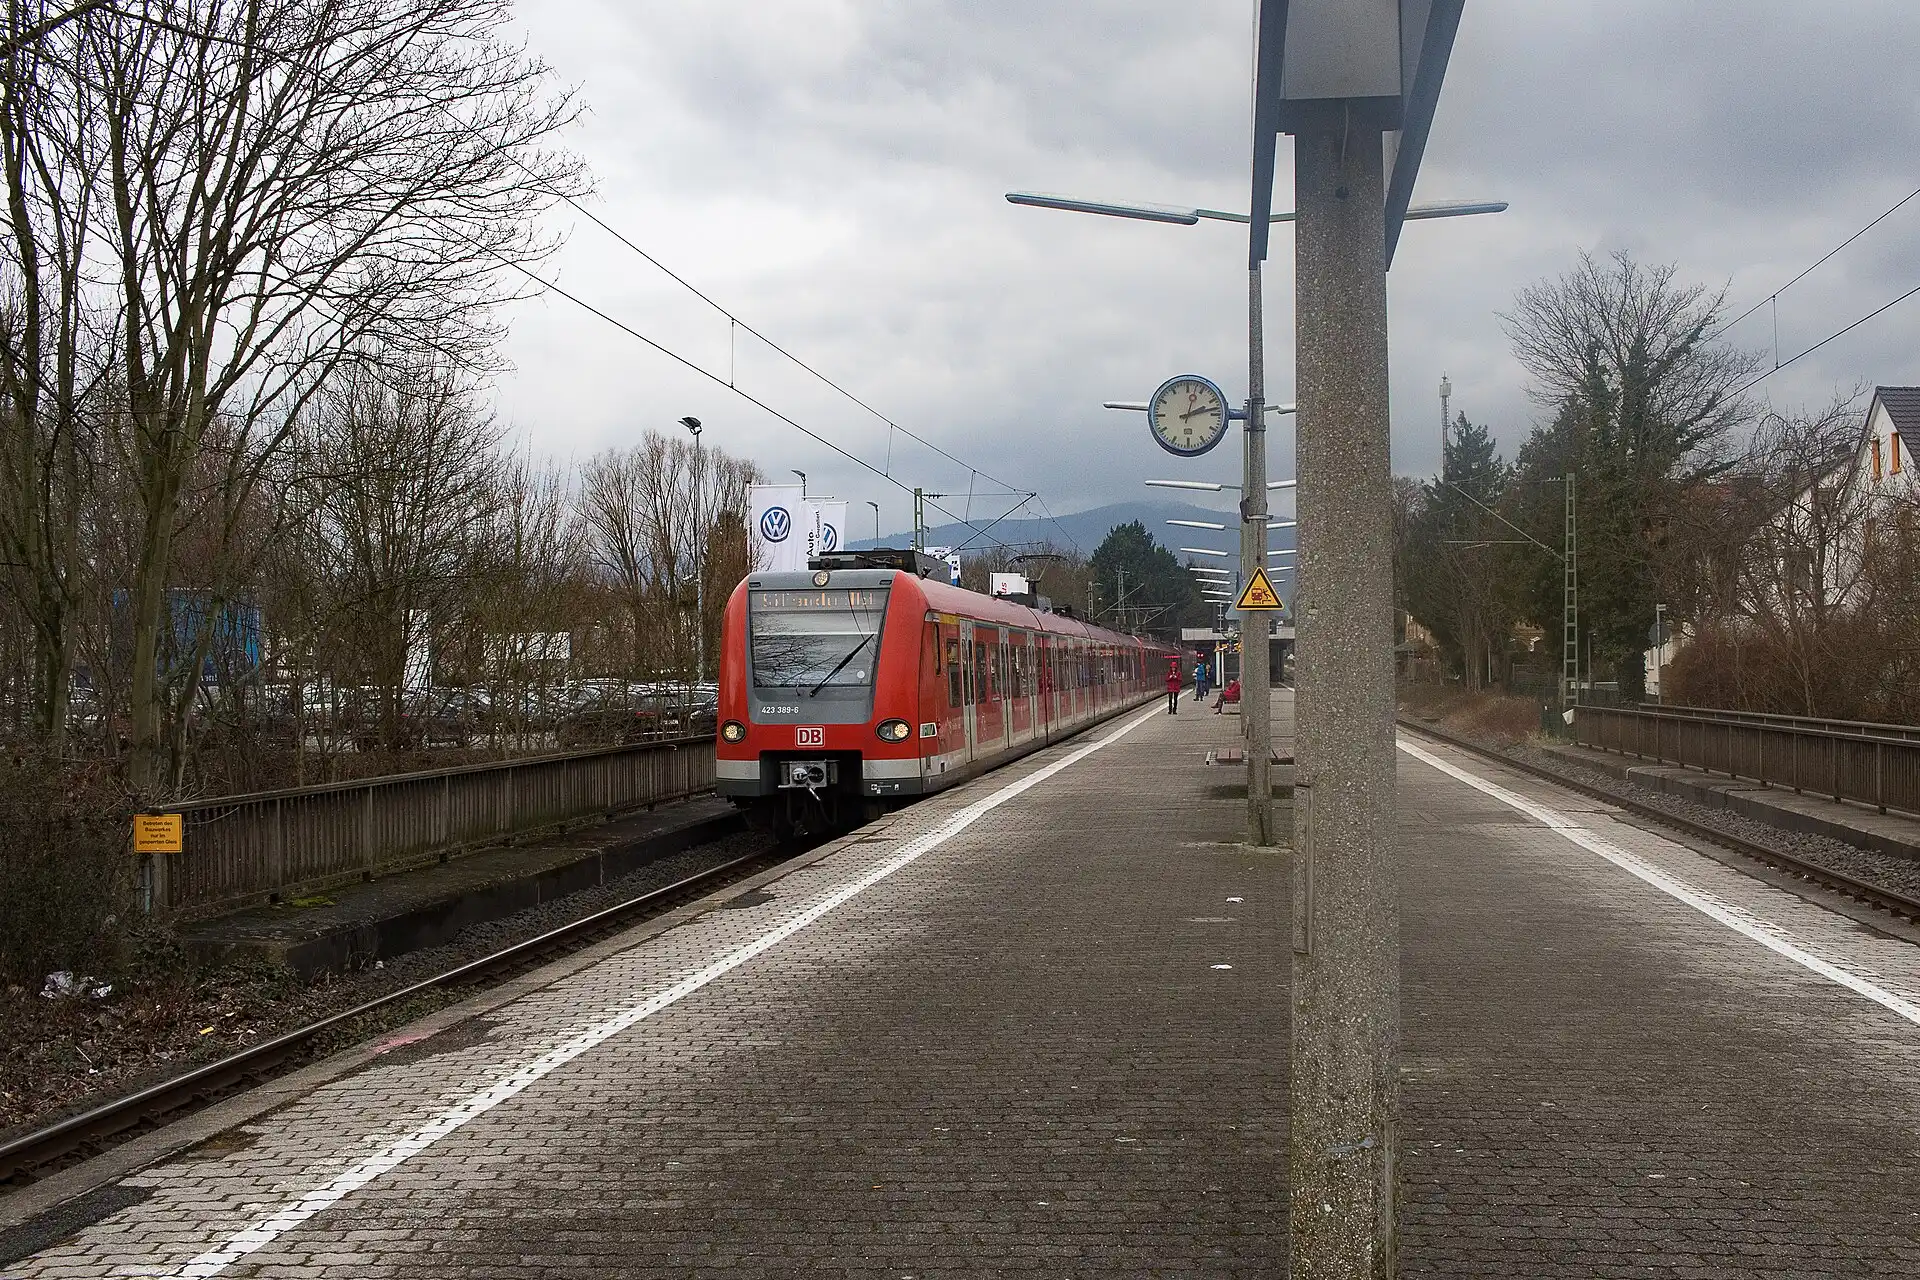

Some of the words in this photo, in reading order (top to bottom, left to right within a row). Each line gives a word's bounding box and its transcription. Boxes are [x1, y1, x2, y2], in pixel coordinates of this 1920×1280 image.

[761, 706, 775, 714] 423
[777, 706, 799, 714] 389-6
[799, 729, 821, 744] DB
